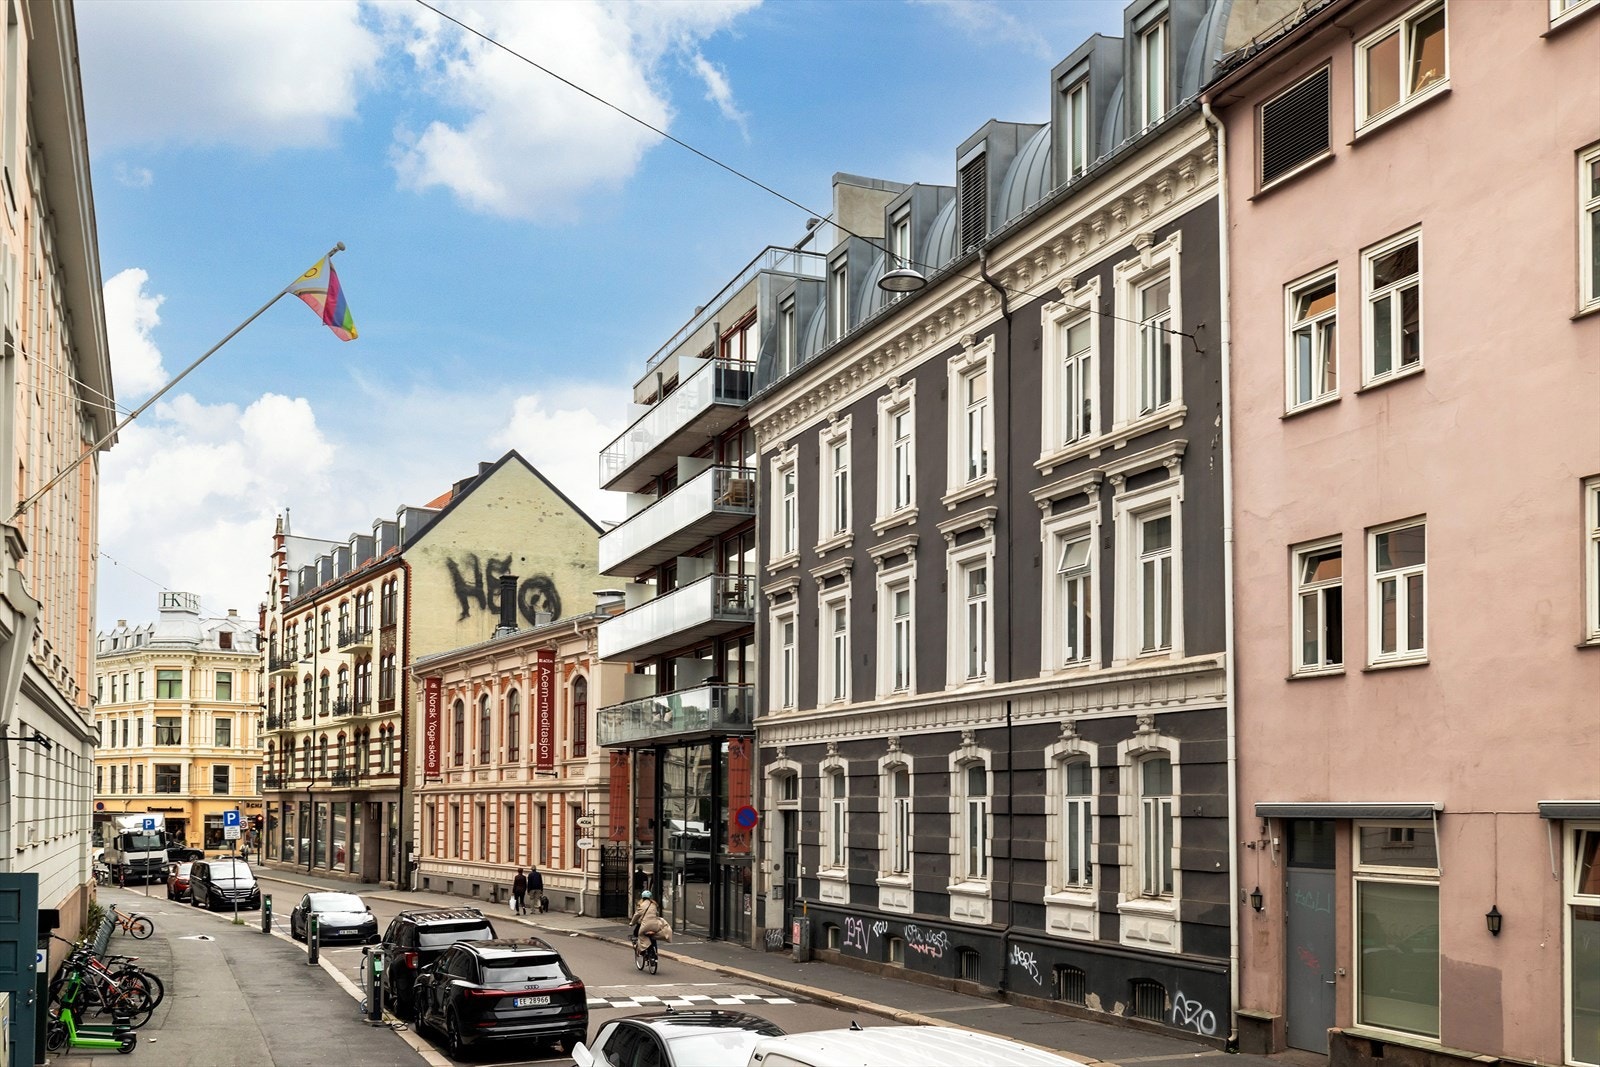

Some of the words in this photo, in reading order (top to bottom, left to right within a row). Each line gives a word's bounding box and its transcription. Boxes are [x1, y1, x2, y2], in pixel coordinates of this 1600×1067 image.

[429, 692, 438, 718] Norsk
[539, 667, 551, 759] Acem-meditasjon
[427, 720, 437, 768] Yoga-skole
[145, 820, 152, 829] P
[227, 812, 236, 825] P
